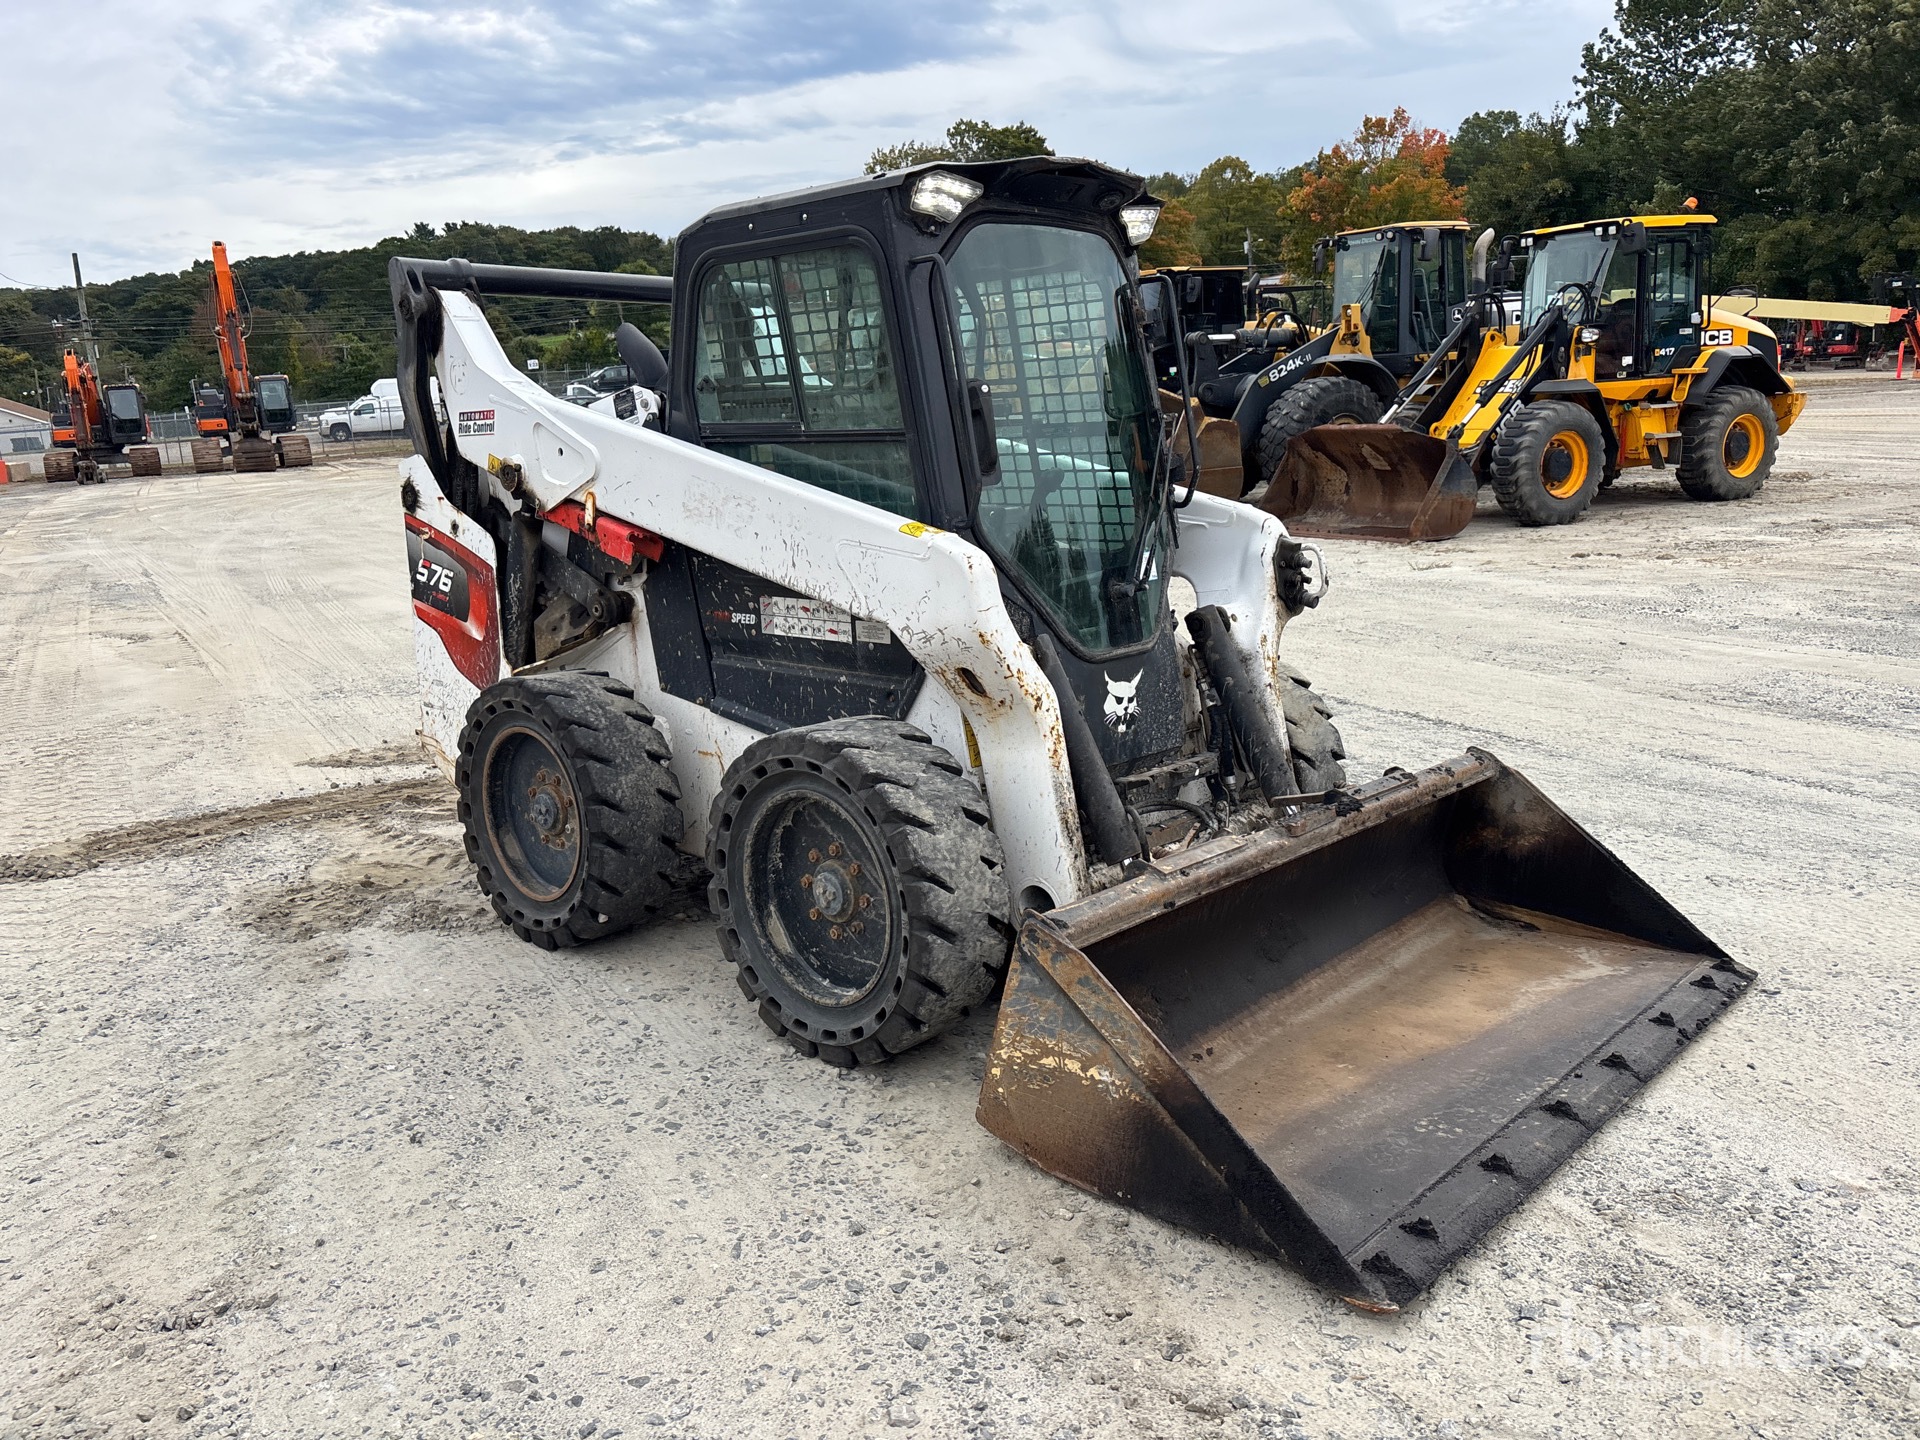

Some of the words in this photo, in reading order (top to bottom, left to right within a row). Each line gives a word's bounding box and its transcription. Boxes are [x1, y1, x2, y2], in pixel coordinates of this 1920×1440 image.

[459, 411, 494, 421] AUTOMATIC
[458, 422, 472, 434] Ride
[472, 420, 495, 434] Control
[731, 612, 756, 625] SPEED
